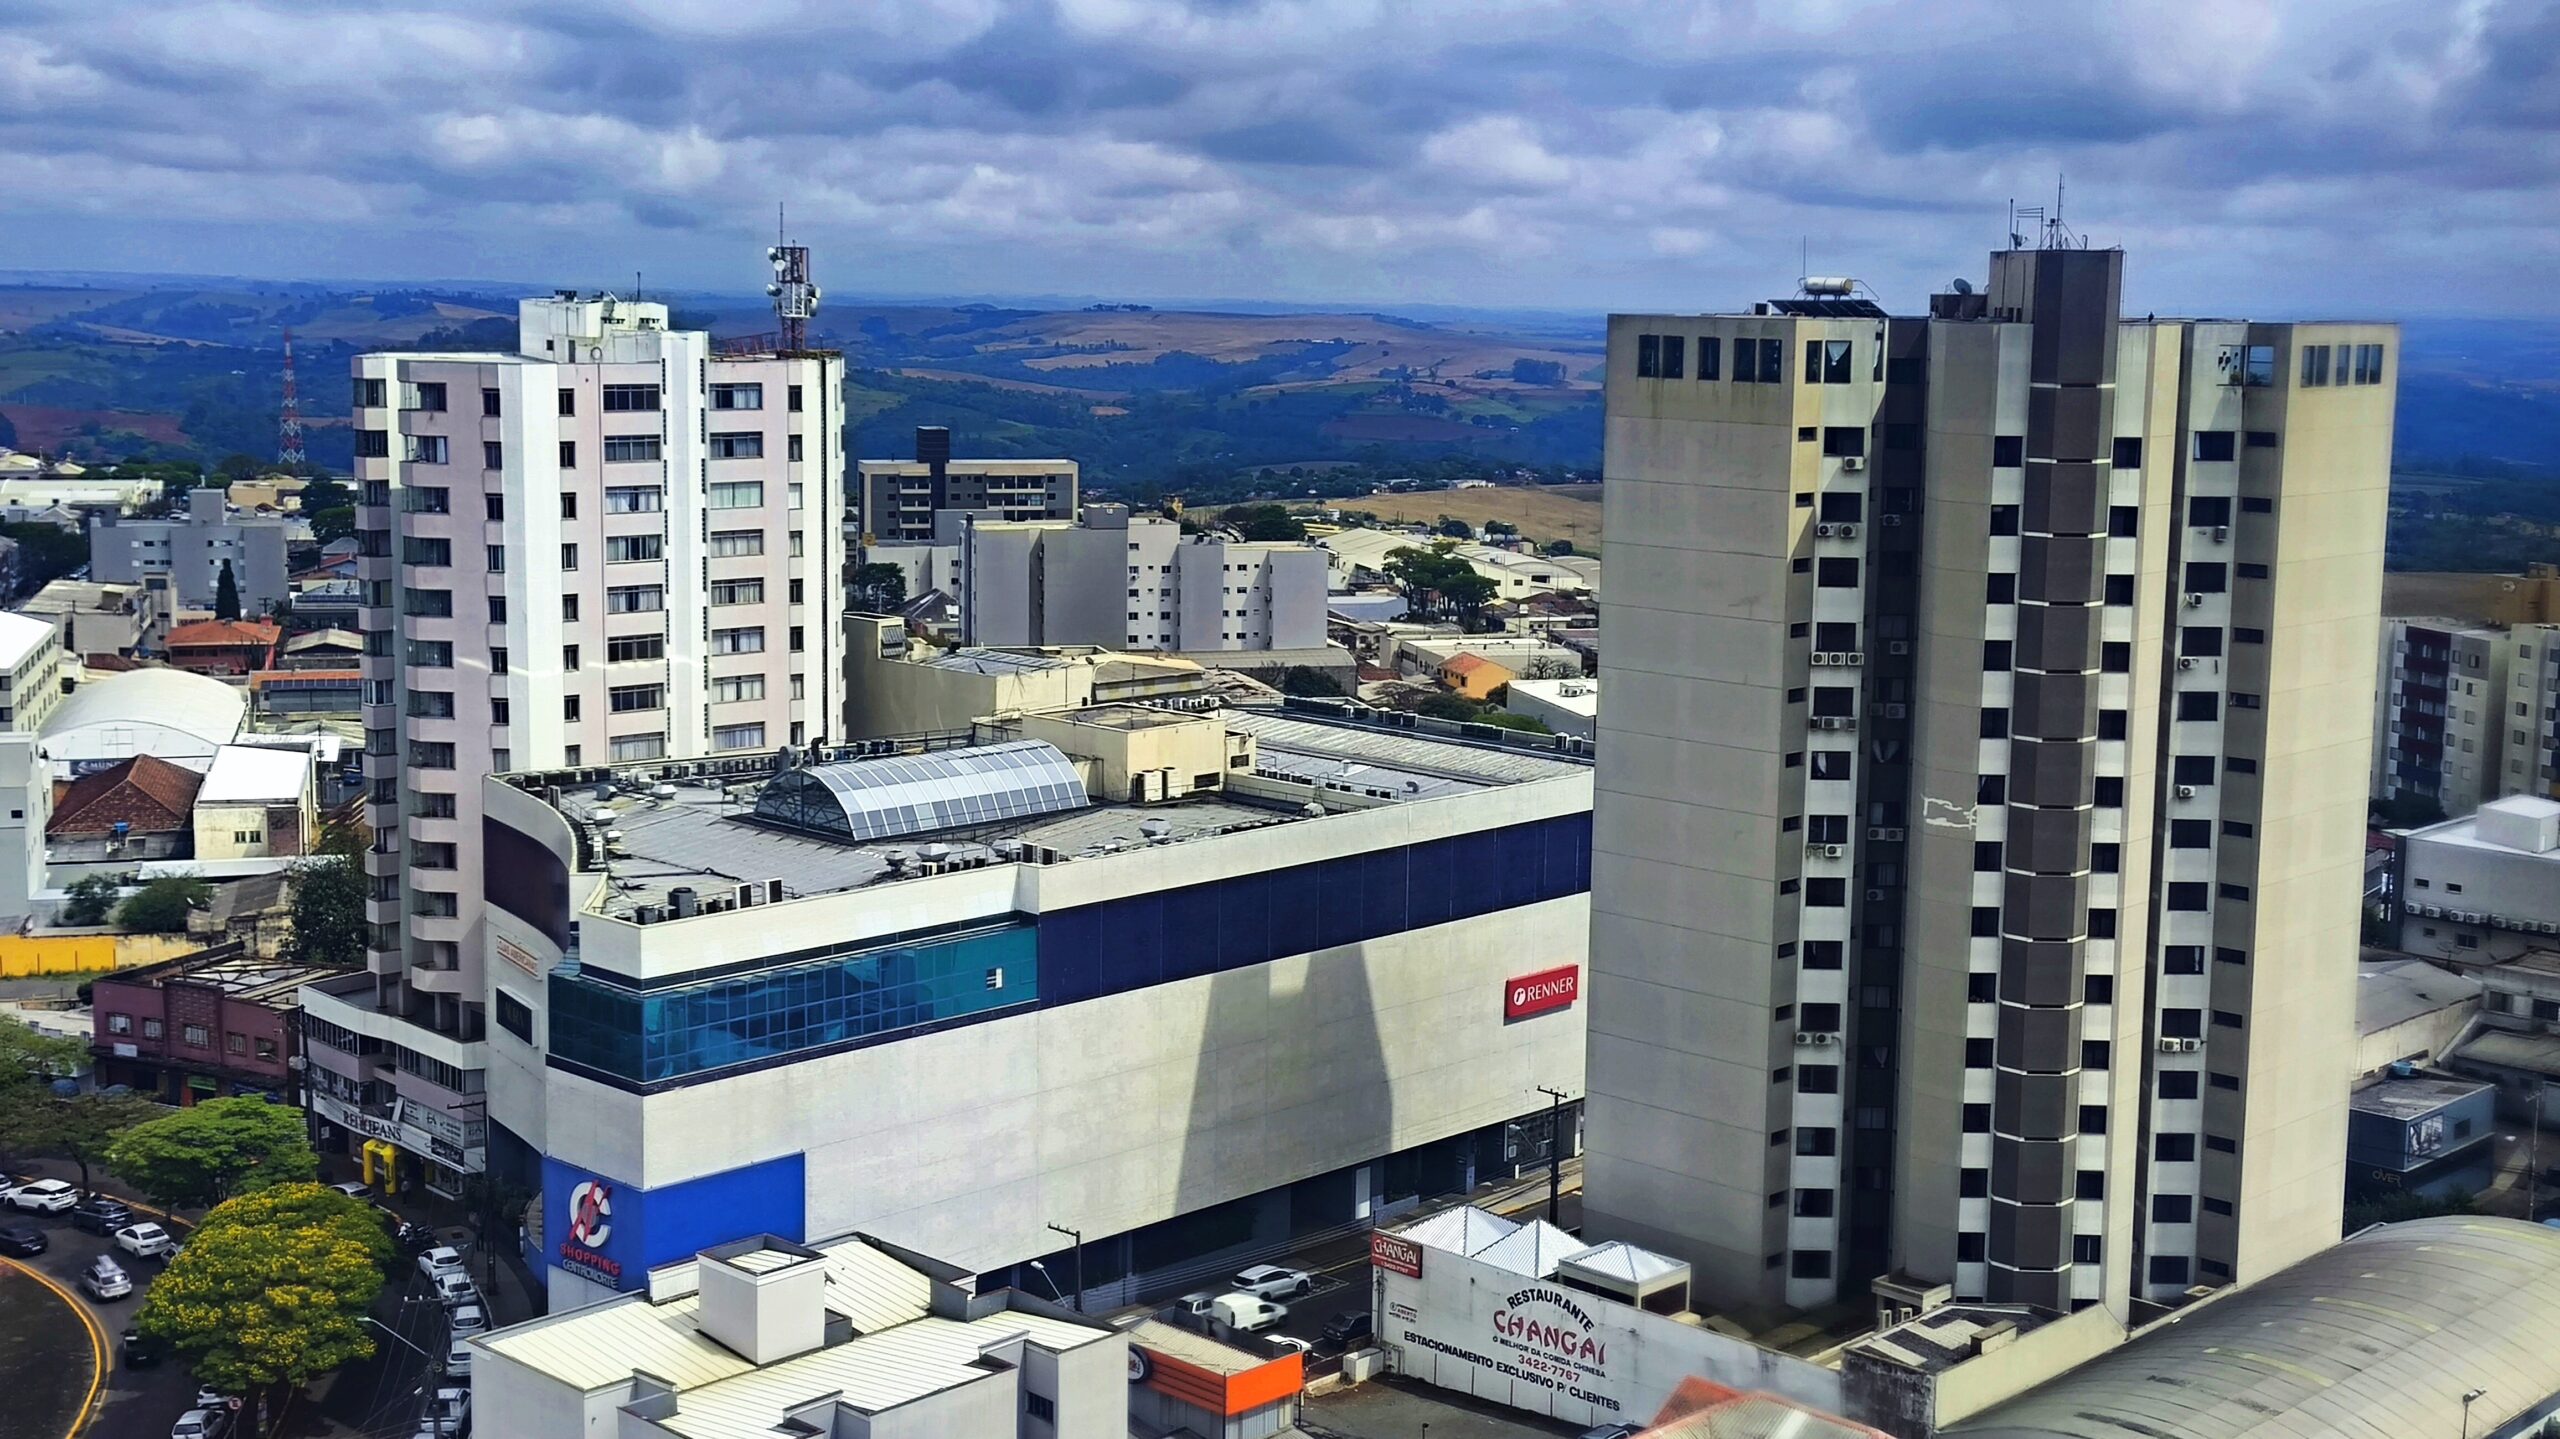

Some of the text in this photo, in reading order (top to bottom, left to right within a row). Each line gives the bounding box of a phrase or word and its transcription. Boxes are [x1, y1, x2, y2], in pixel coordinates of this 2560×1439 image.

[1527, 976, 1574, 1002] RENNER
[560, 1243, 622, 1275] SHOPPING
[1374, 1239, 1417, 1264] CHANGAI
[1507, 1289, 1594, 1333] RESTAURANTE
[1494, 1310, 1606, 1365] CHANGAI
[1404, 1331, 1493, 1368] ESTACIONAMENTO
[1497, 1362, 1553, 1389] EXCLUSIVO
[1569, 1387, 1620, 1411] CLIENTES
[1500, 1338, 1529, 1353] MELHOR
[1531, 1348, 1541, 1357] DA
[1543, 1352, 1571, 1368] COMIDA
[1574, 1362, 1606, 1378] CHINESA
[1518, 1354, 1580, 1382] 3422-7767
